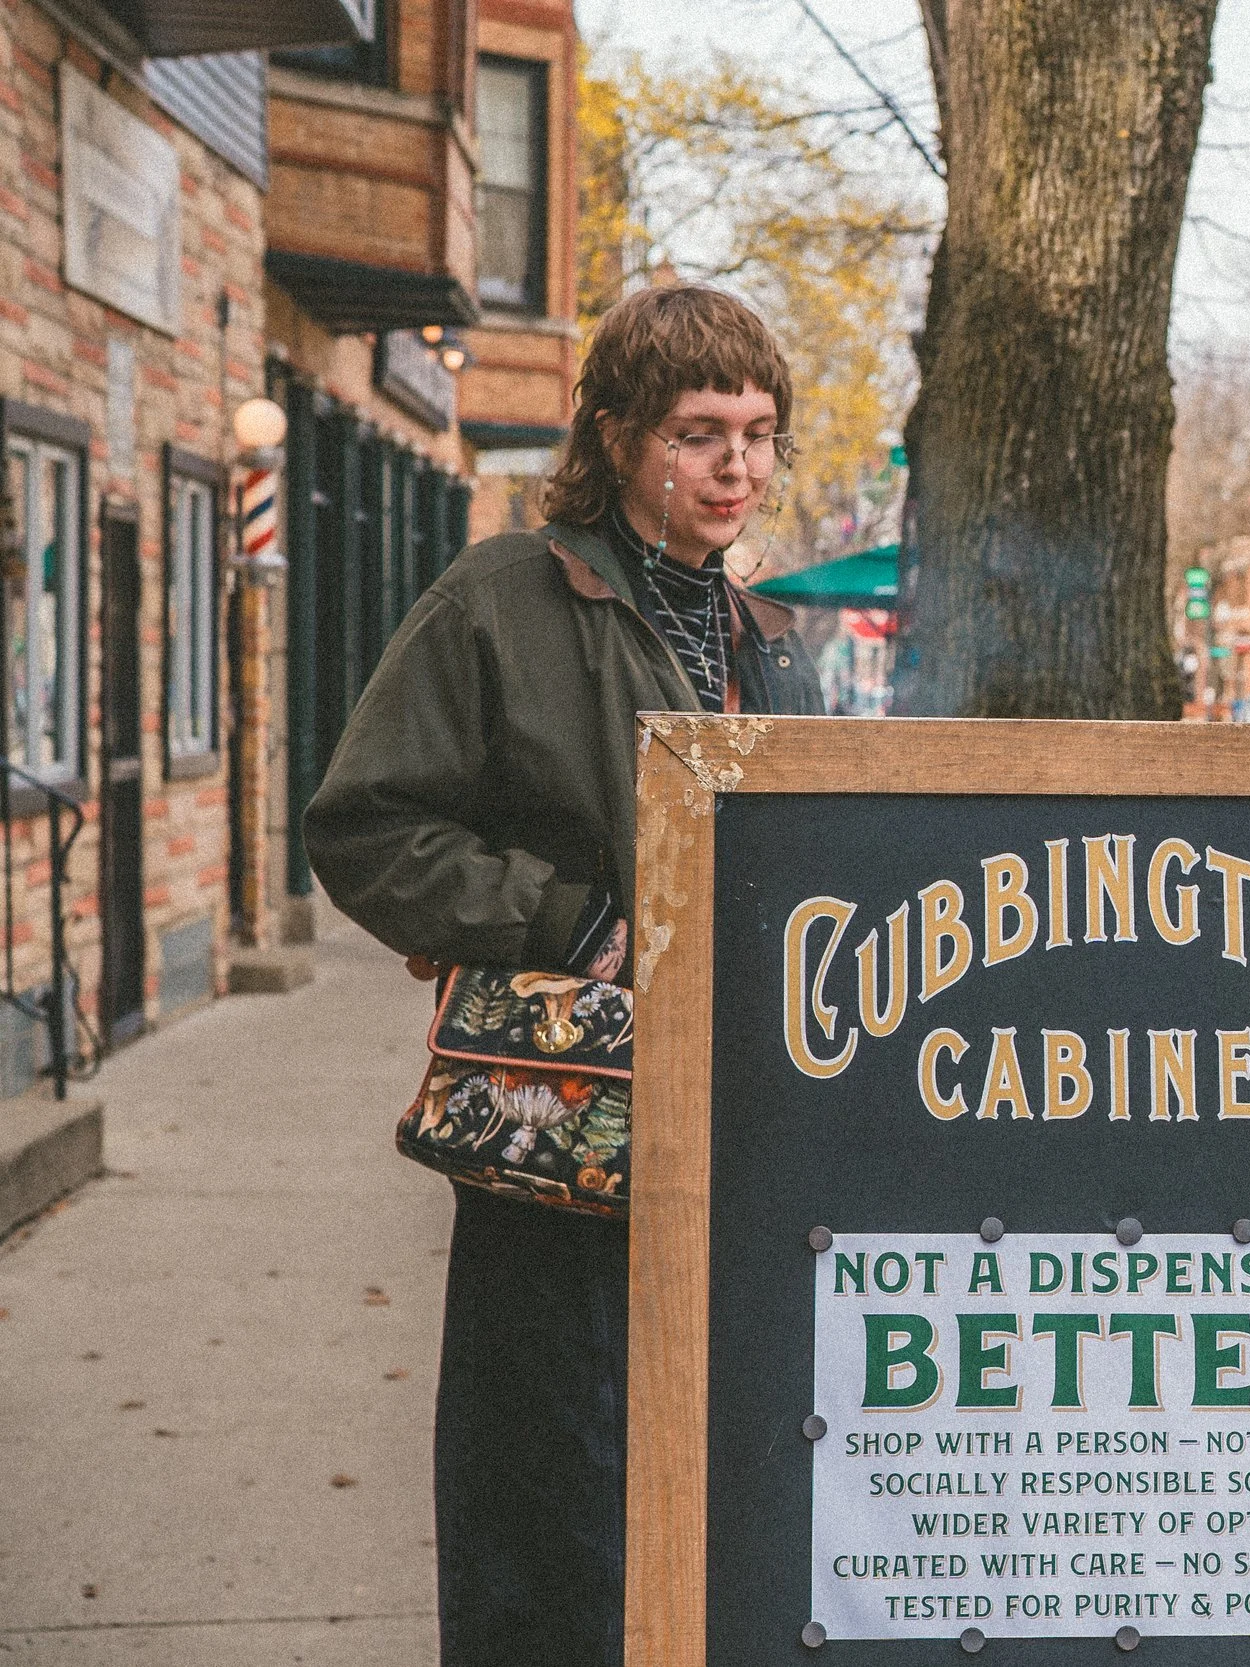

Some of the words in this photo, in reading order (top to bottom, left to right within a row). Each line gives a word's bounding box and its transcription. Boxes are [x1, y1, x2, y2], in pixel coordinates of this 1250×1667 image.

[833, 1252, 948, 1296] NOT
[968, 1252, 1007, 1296] A
[845, 1432, 923, 1457] SHOP
[935, 1432, 1014, 1455] WITH
[1025, 1432, 1044, 1455] A
[1056, 1431, 1170, 1455] PERSON
[870, 1472, 1009, 1497] SOCIALLY
[1021, 1471, 1217, 1496] RESPONSIBLE
[912, 1513, 1009, 1537] WIDER
[1023, 1512, 1145, 1536] VARIETY
[1158, 1511, 1195, 1535] OF
[833, 1555, 968, 1579] CURATED
[980, 1554, 1058, 1578] WITH
[1070, 1553, 1146, 1578] CARE
[1183, 1552, 1222, 1576] NO
[885, 1596, 993, 1620] TESTED
[1006, 1595, 1062, 1619] FOR
[1075, 1593, 1180, 1618] PURITY
[1191, 1593, 1214, 1620] &
